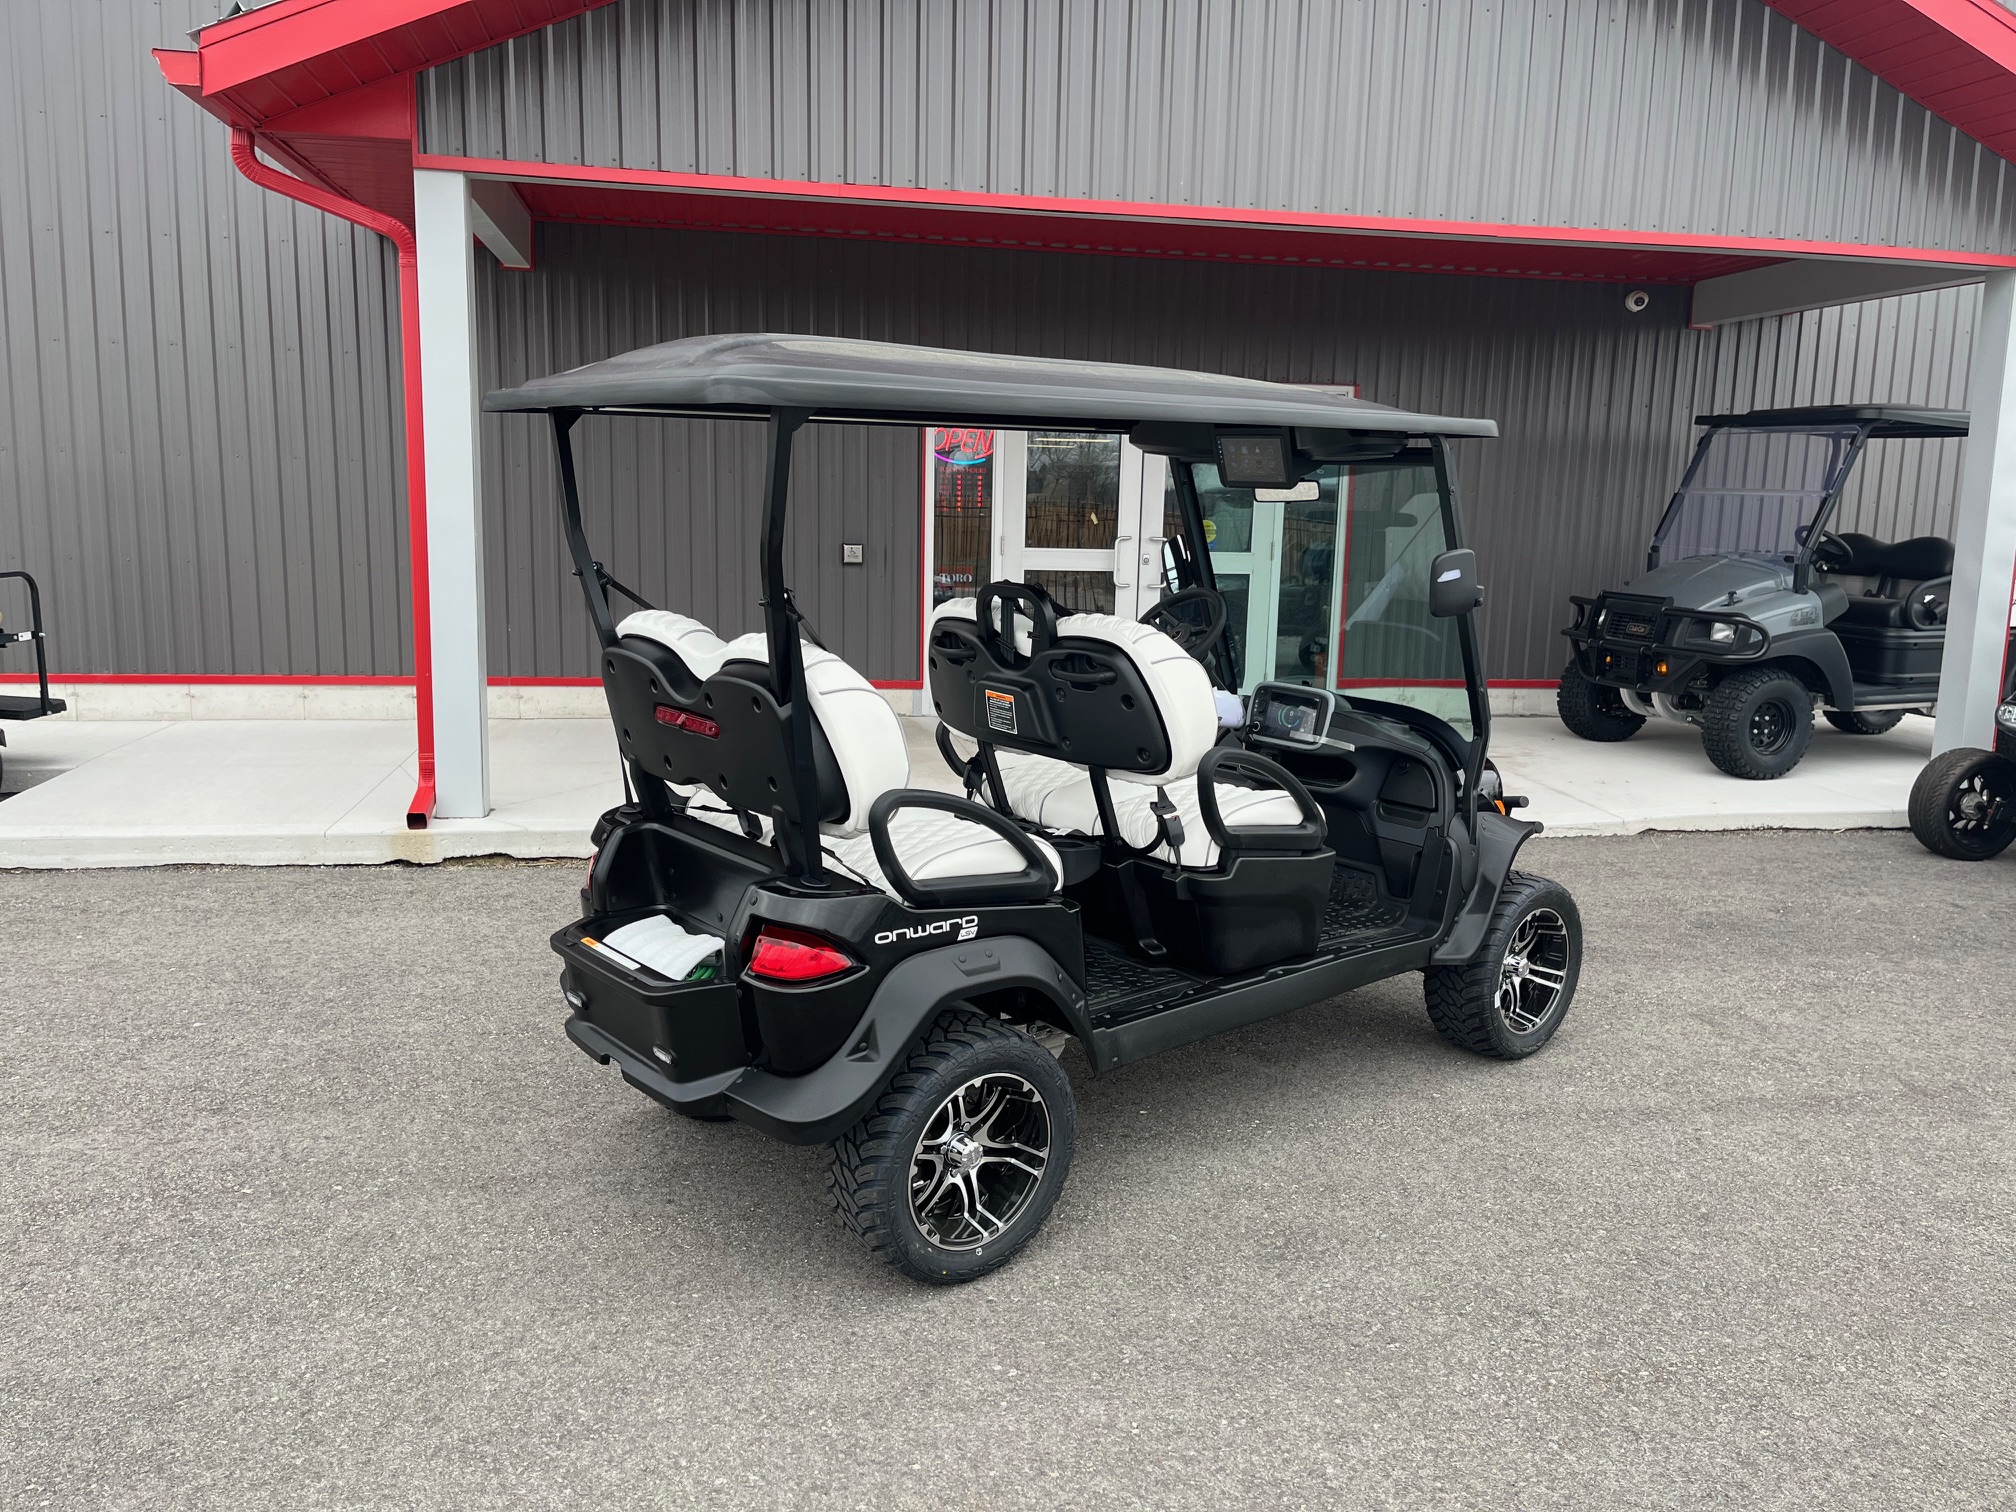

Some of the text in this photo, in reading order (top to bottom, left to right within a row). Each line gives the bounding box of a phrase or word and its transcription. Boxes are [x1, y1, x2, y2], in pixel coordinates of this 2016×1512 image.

[935, 427, 994, 453] OPEN
[940, 573, 973, 584] TORO
[960, 929, 976, 938] LSV
